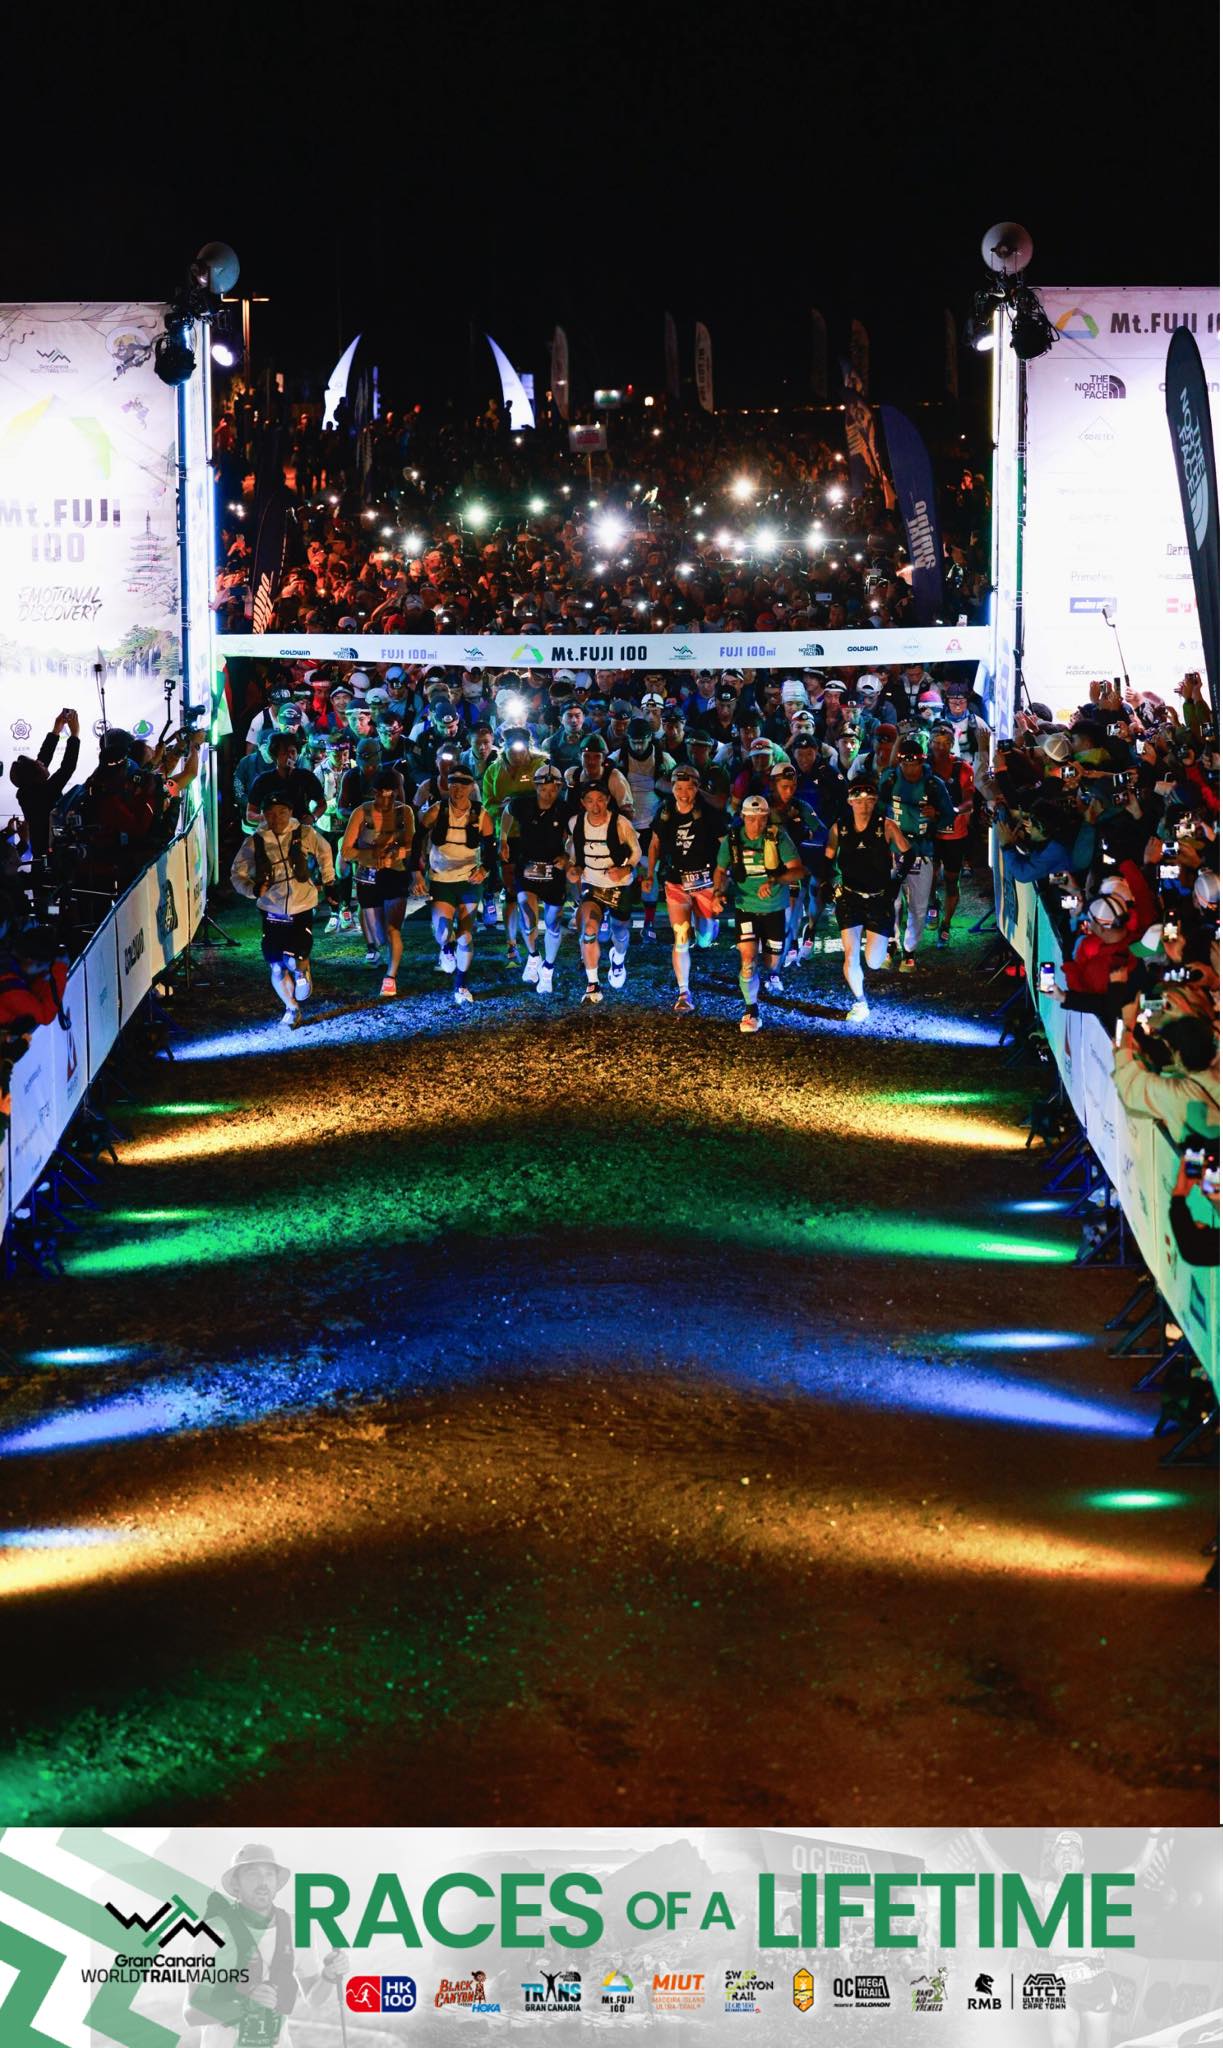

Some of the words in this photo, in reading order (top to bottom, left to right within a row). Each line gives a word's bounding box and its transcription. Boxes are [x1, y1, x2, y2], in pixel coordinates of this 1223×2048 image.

[1207, 313, 1220, 333] 1
[1074, 383, 1109, 391] NORTH
[1090, 375, 1108, 383] THE
[1084, 391, 1109, 399] FACE
[1180, 387, 1202, 488] NORTH
[31, 533, 86, 562] 100
[18, 586, 101, 603] EMOTIONAL
[19, 603, 102, 622] DISCOVERY
[381, 648, 404, 659] FUJI
[551, 646, 614, 662] Mt.FUJI
[620, 645, 648, 661] 100
[720, 646, 743, 657] FUJI
